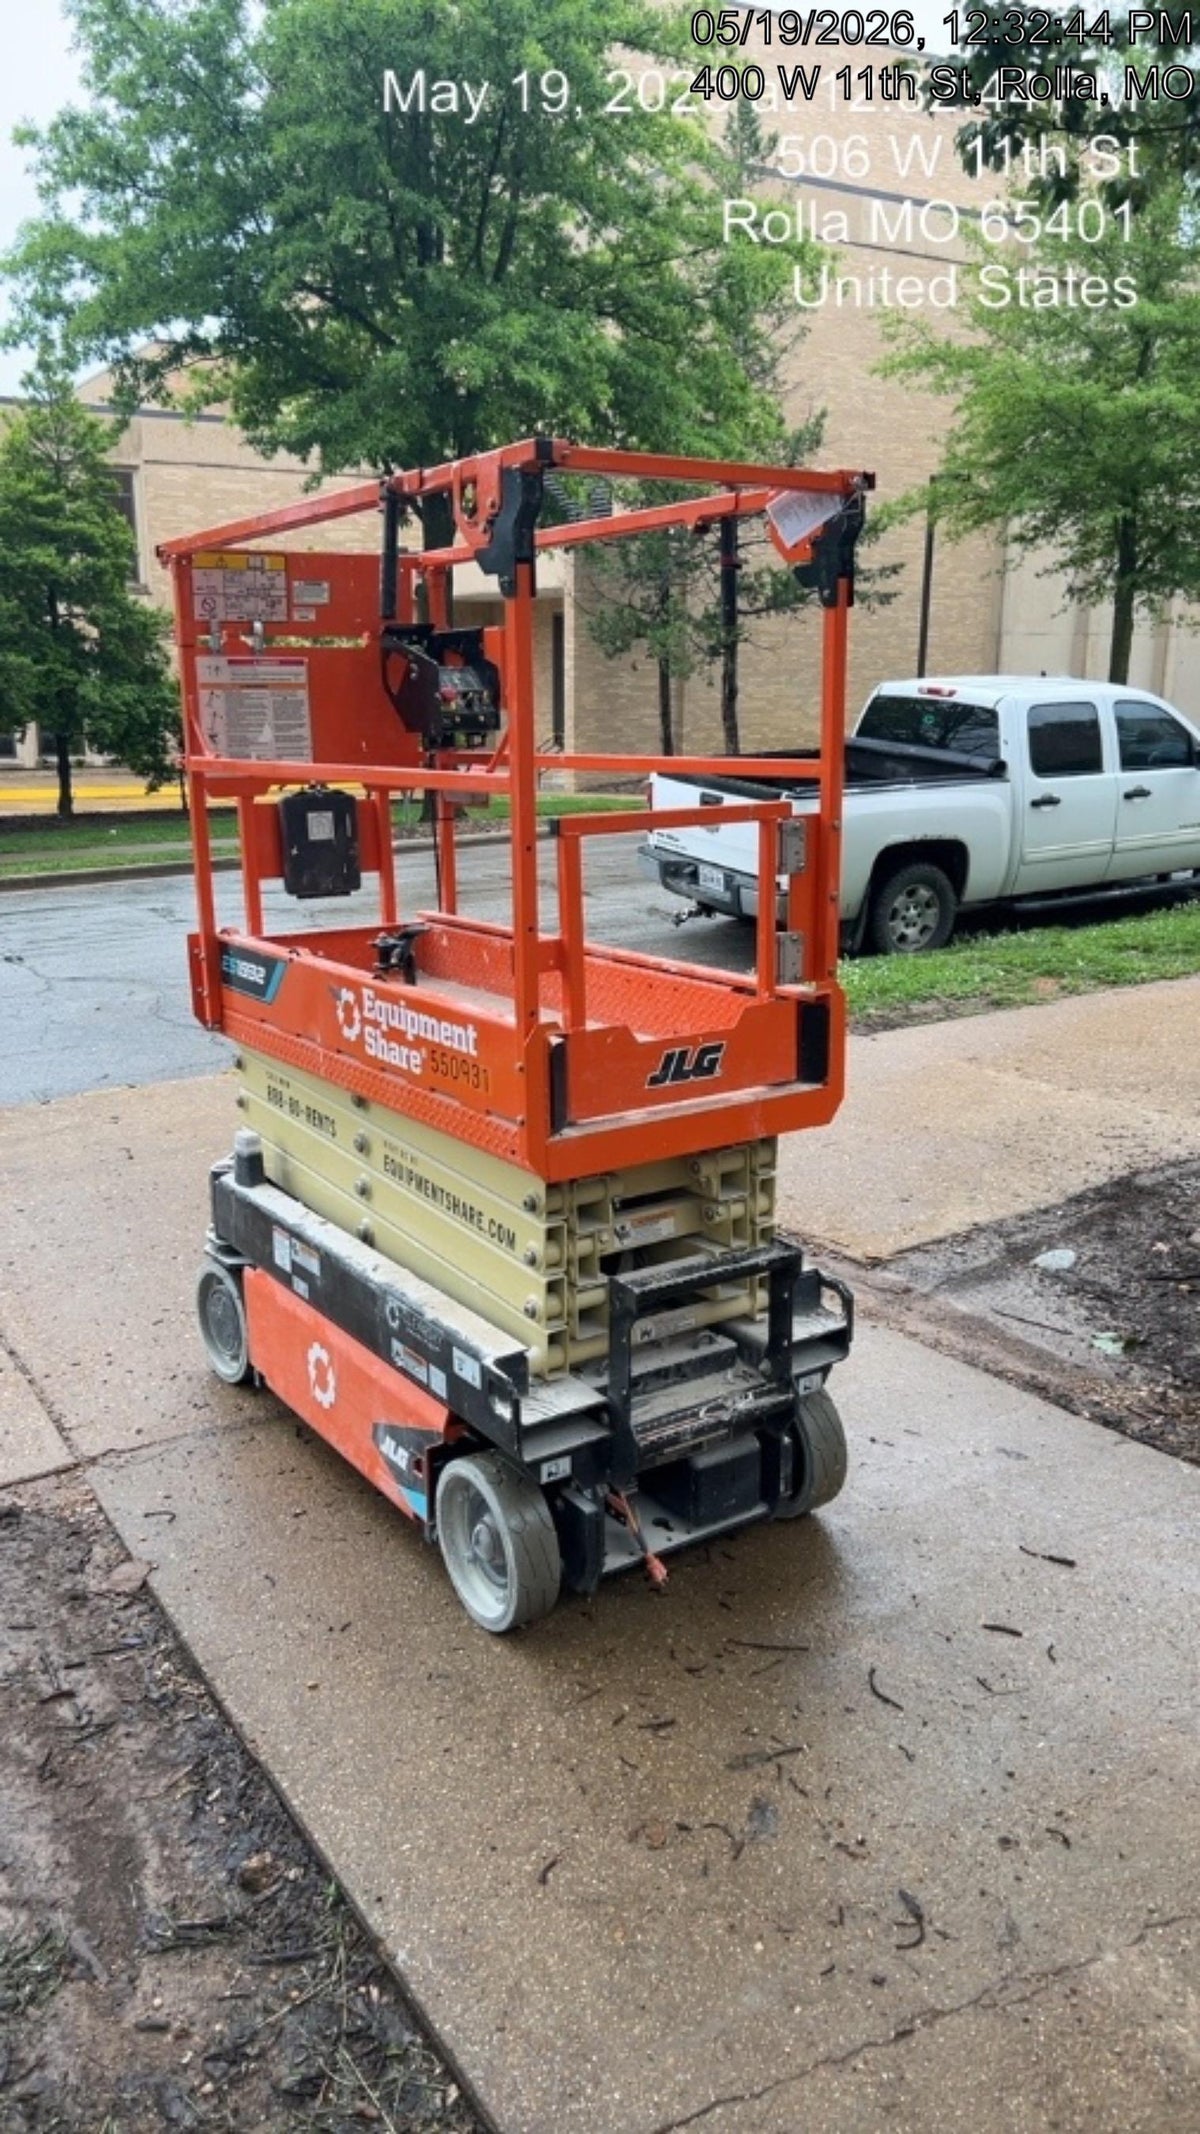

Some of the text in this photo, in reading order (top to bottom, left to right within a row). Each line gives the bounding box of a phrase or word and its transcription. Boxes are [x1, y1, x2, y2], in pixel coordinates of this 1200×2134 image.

[361, 986, 479, 1058] Equipment
[430, 1049, 490, 1093] 550931
[645, 1040, 725, 1090] JLG
[383, 1153, 516, 1252] EQUIPMENTSHARE.COM
